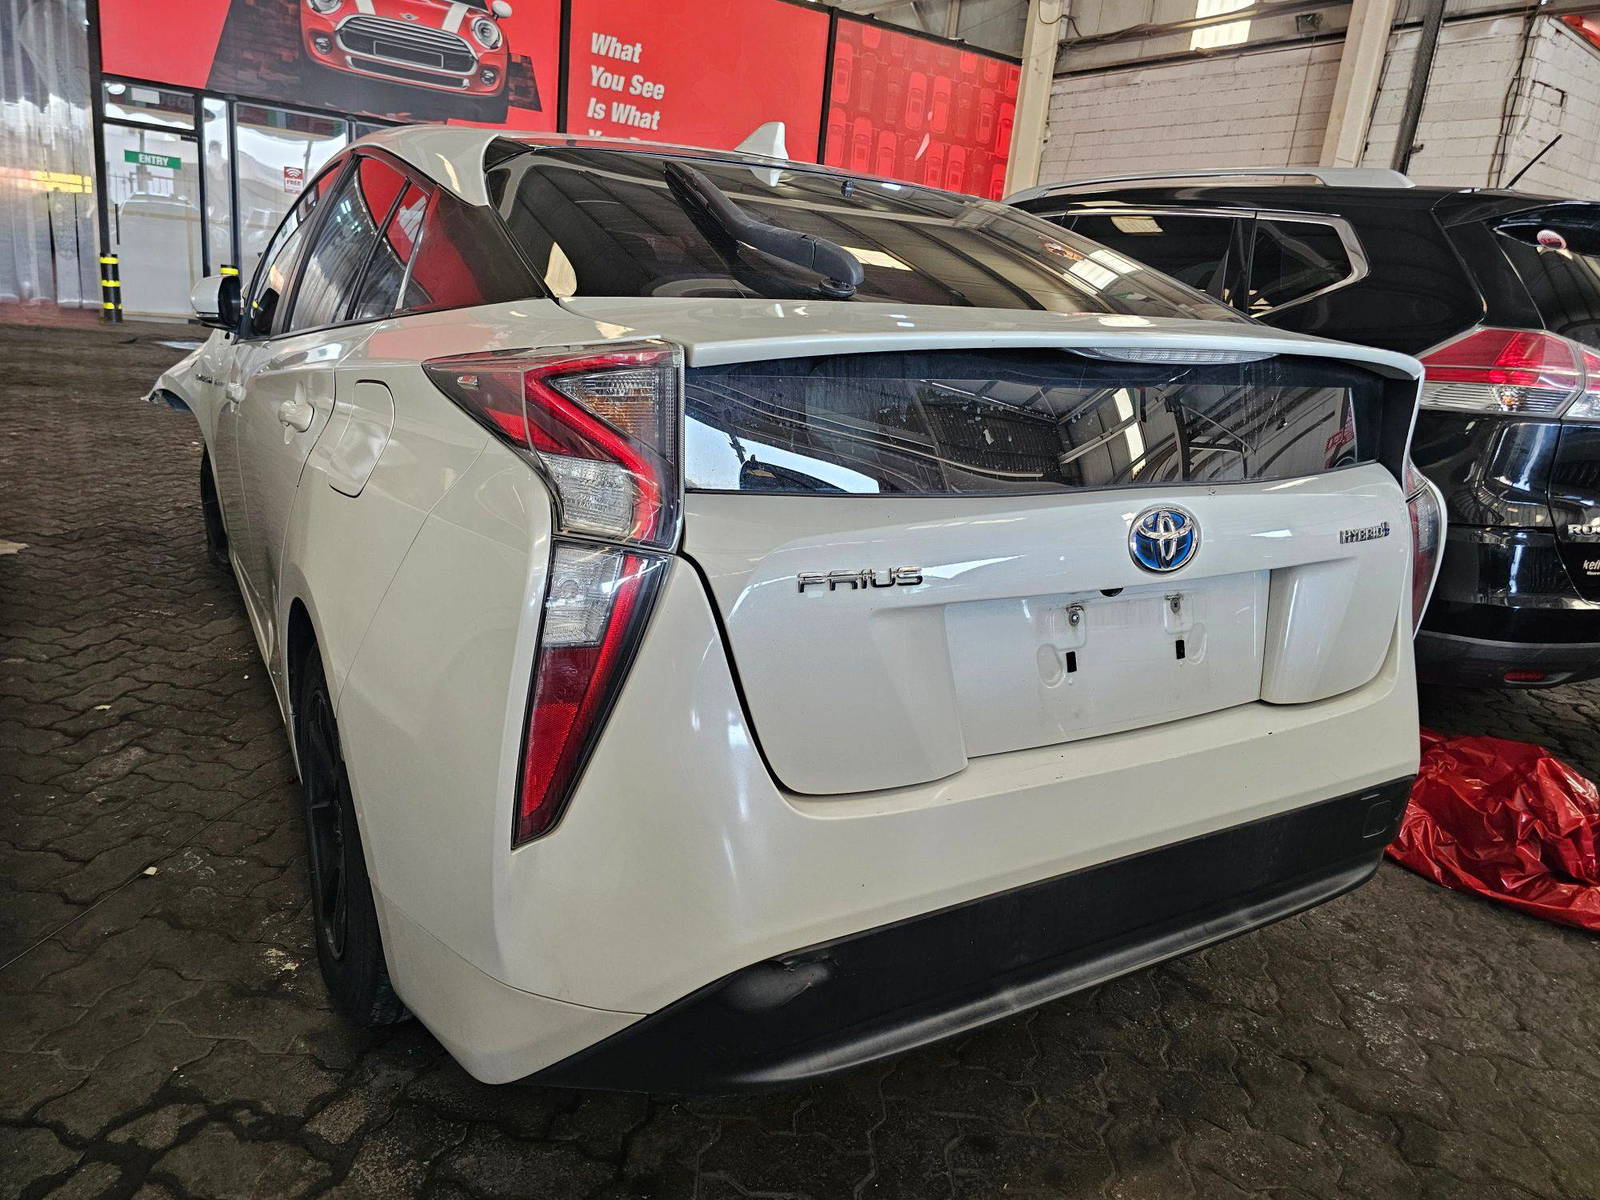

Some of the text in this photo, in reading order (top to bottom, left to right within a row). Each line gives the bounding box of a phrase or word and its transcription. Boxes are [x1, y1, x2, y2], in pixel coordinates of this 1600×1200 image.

[591, 32, 642, 63] What
[590, 65, 664, 99] You See
[587, 97, 660, 130] Is What
[138, 153, 169, 167] ENTRY
[1338, 524, 1386, 544] HYBRID
[797, 566, 923, 593] PRIUS
